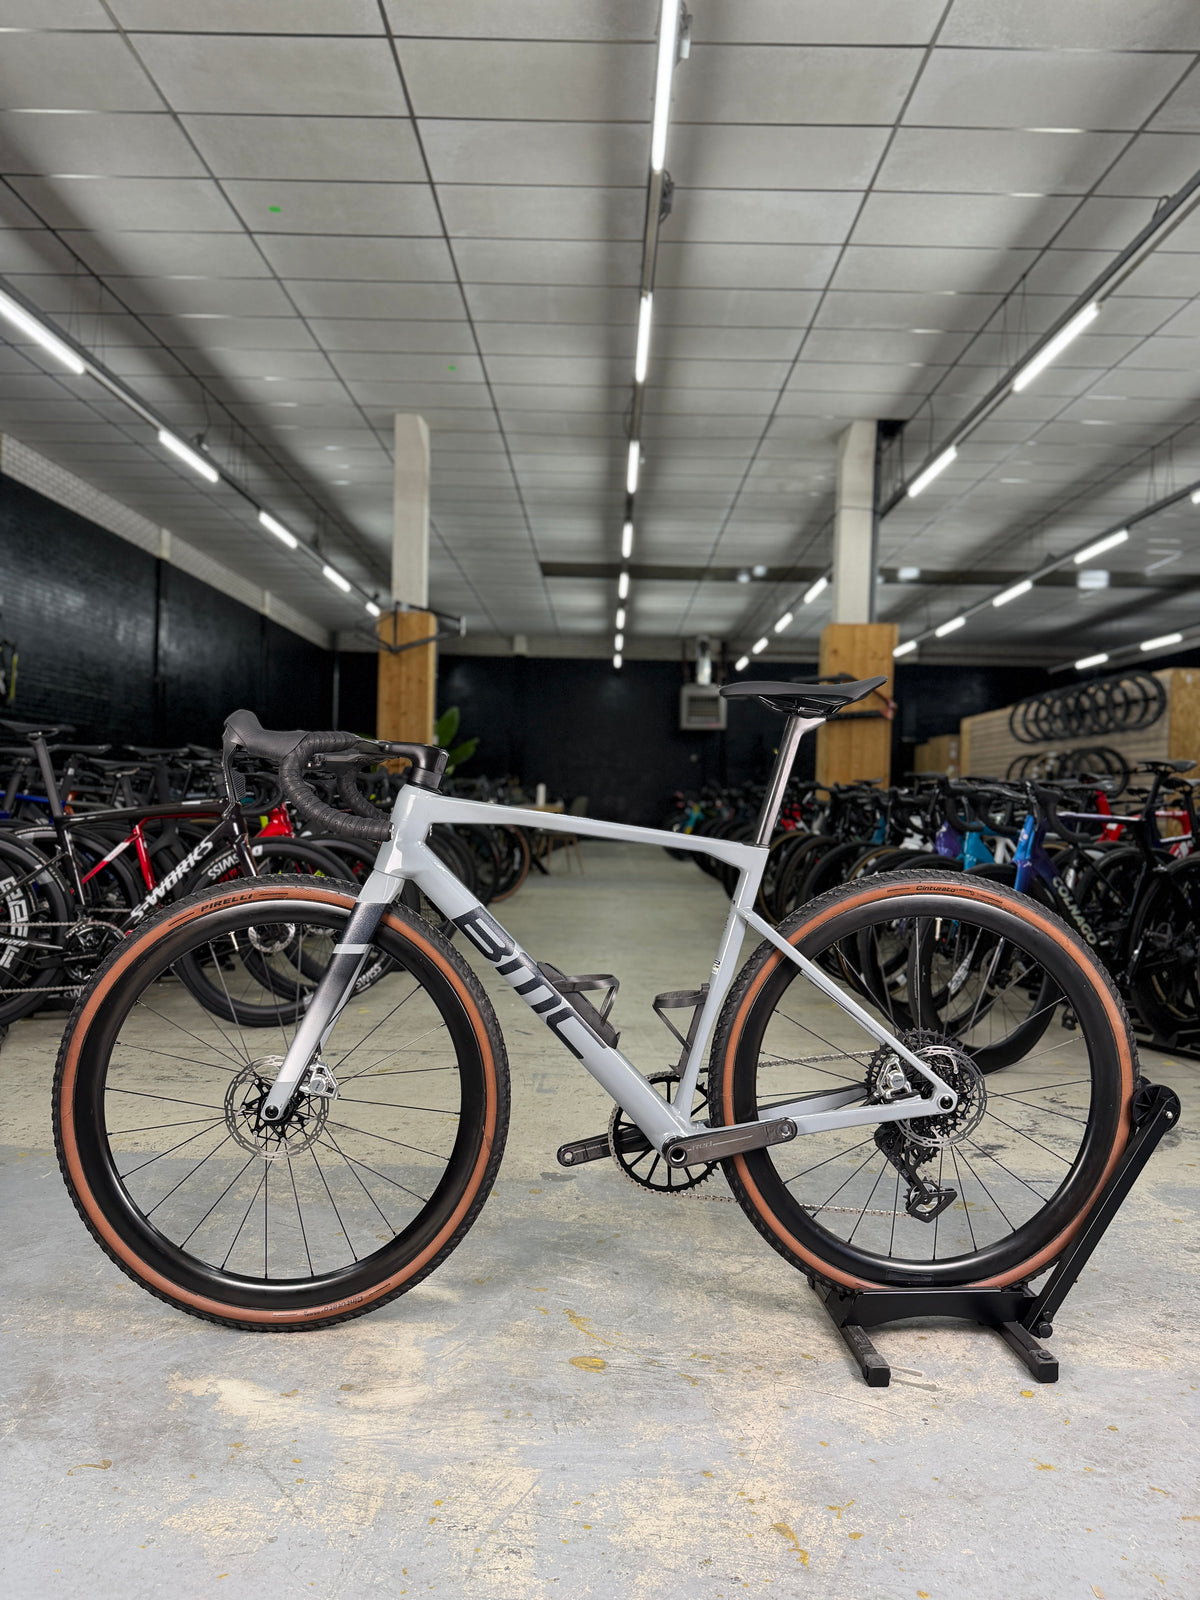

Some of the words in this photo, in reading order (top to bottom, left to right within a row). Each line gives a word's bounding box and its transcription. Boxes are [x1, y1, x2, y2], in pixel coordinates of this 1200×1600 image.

[130, 840, 214, 924] S-WORKS
[200, 893, 253, 912] PIRELLI
[1052, 876, 1097, 945] COLNAGO
